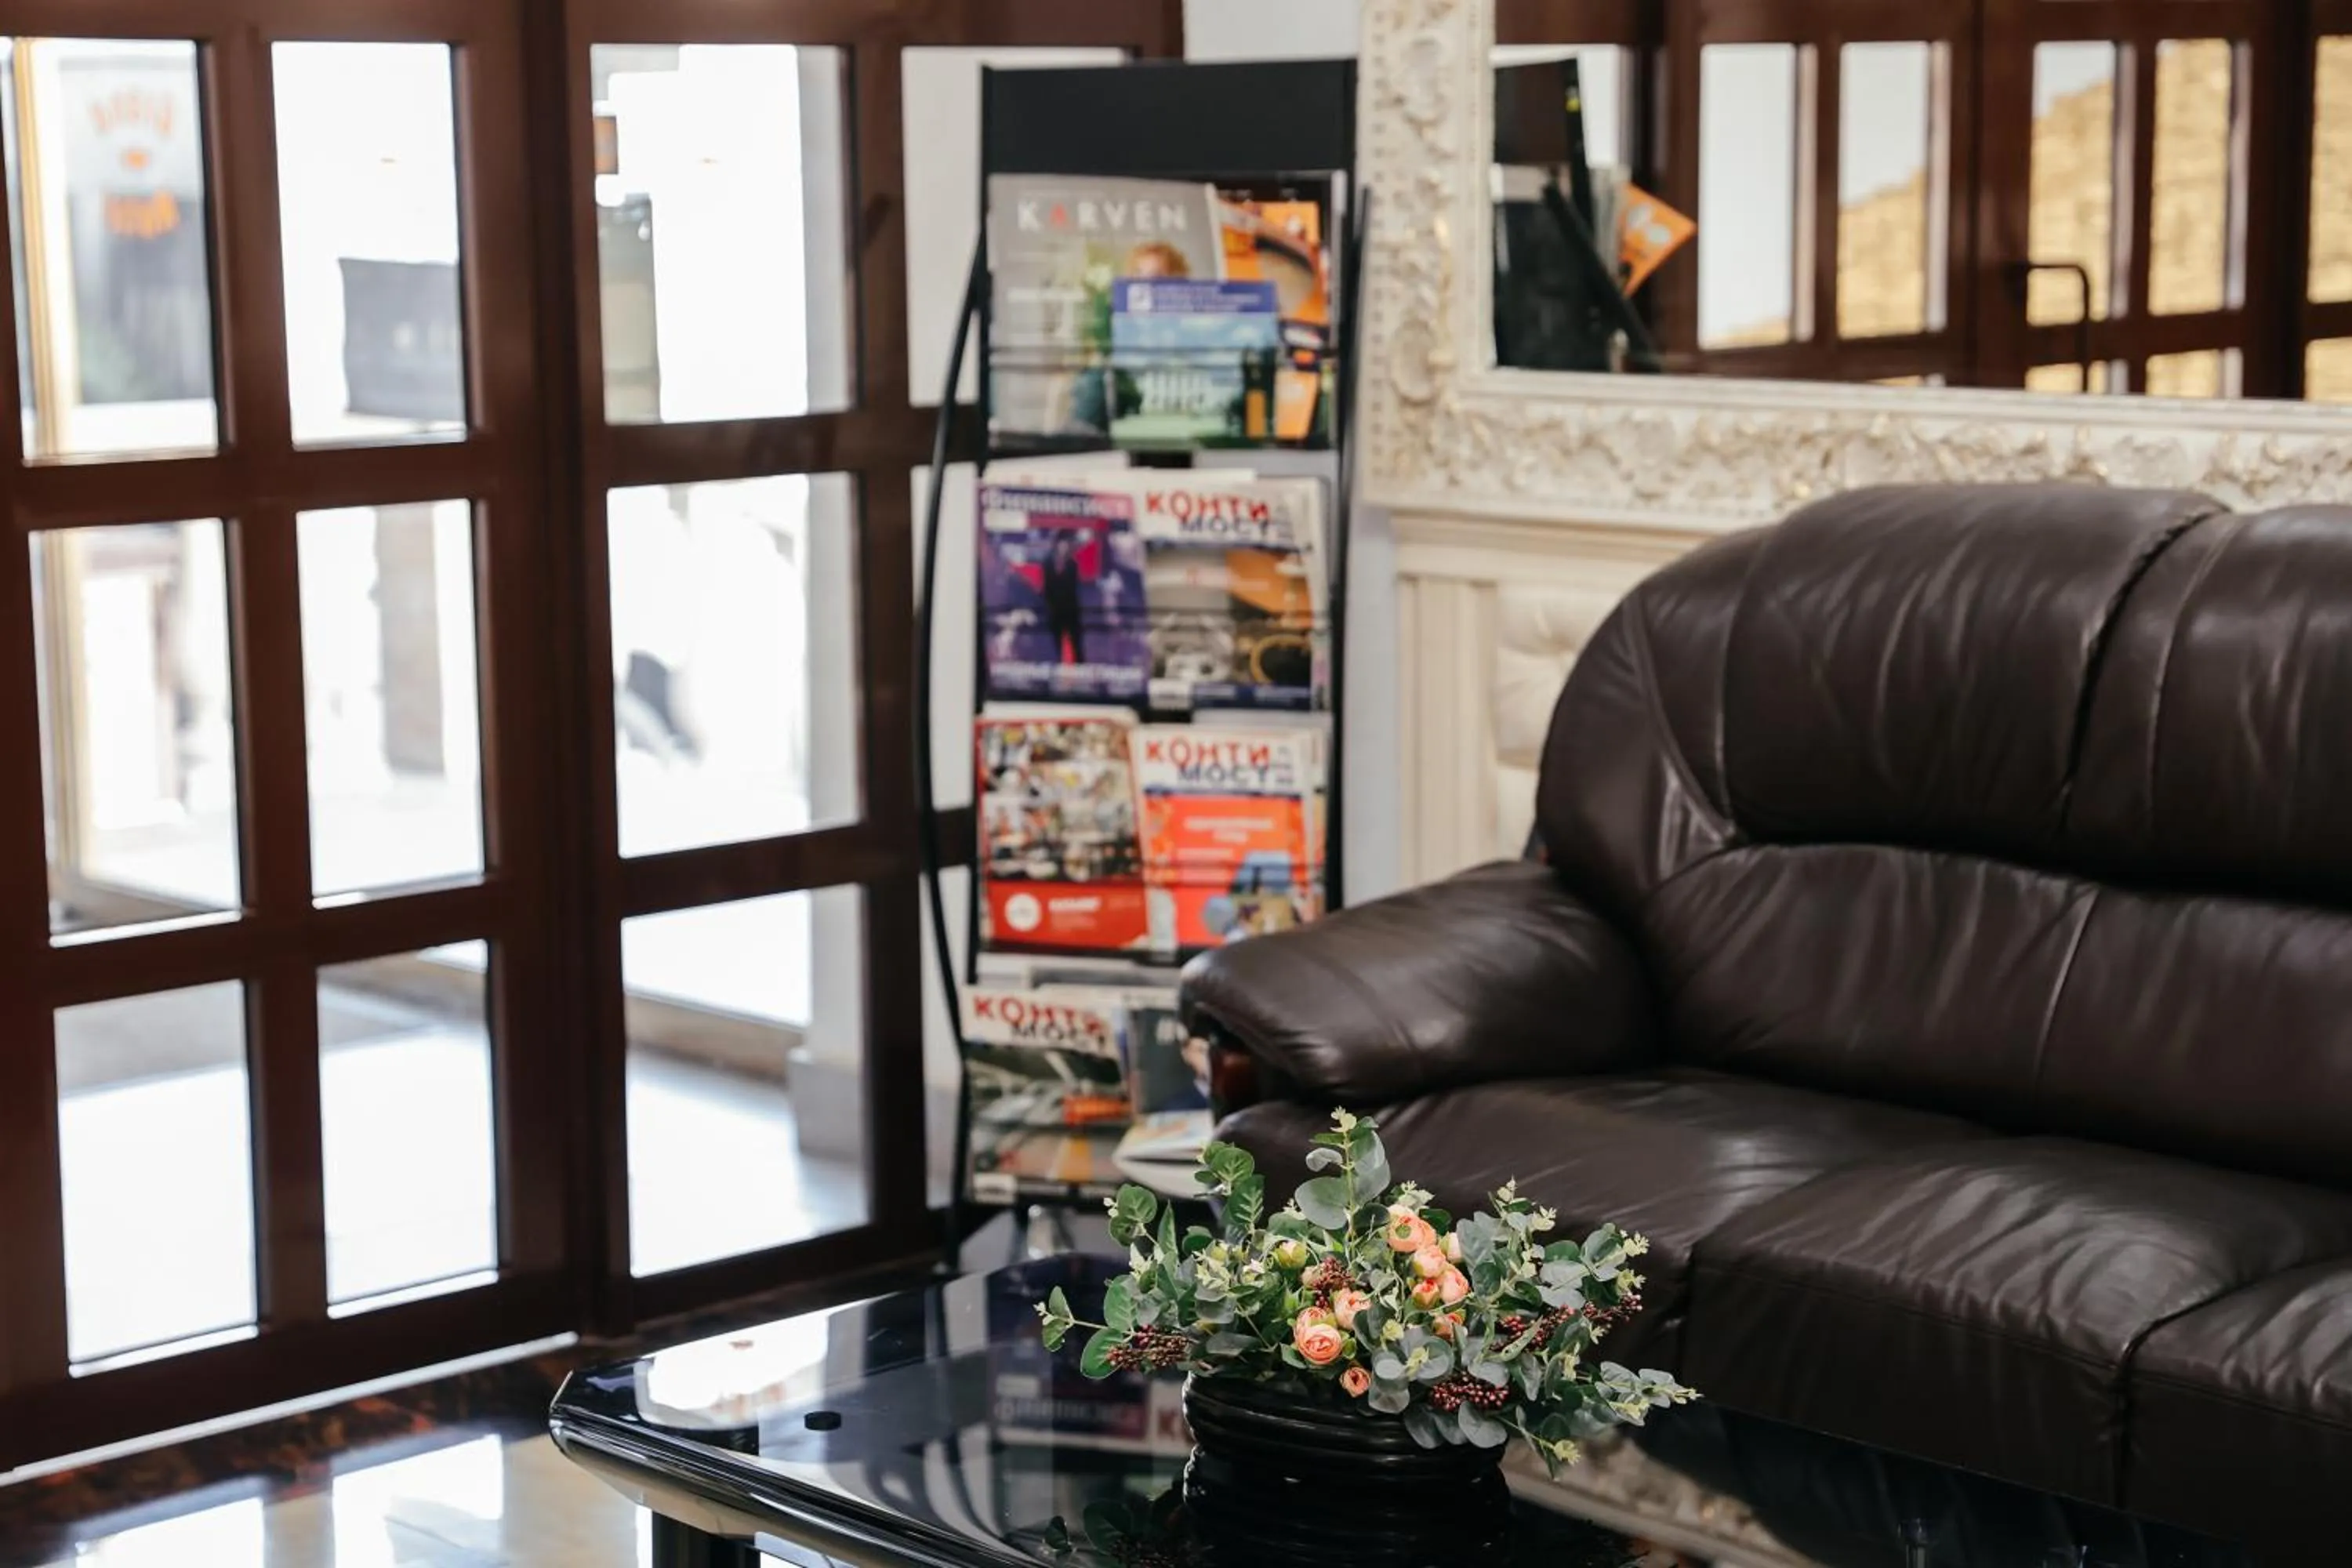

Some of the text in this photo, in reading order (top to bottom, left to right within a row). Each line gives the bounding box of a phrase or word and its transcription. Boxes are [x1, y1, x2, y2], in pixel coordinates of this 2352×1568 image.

[1017, 201, 1188, 232] KARVEN
[1146, 490, 1270, 524] КОНТИ
[1145, 735, 1269, 770] КОНТИ
[1179, 762, 1269, 783] МОСТ
